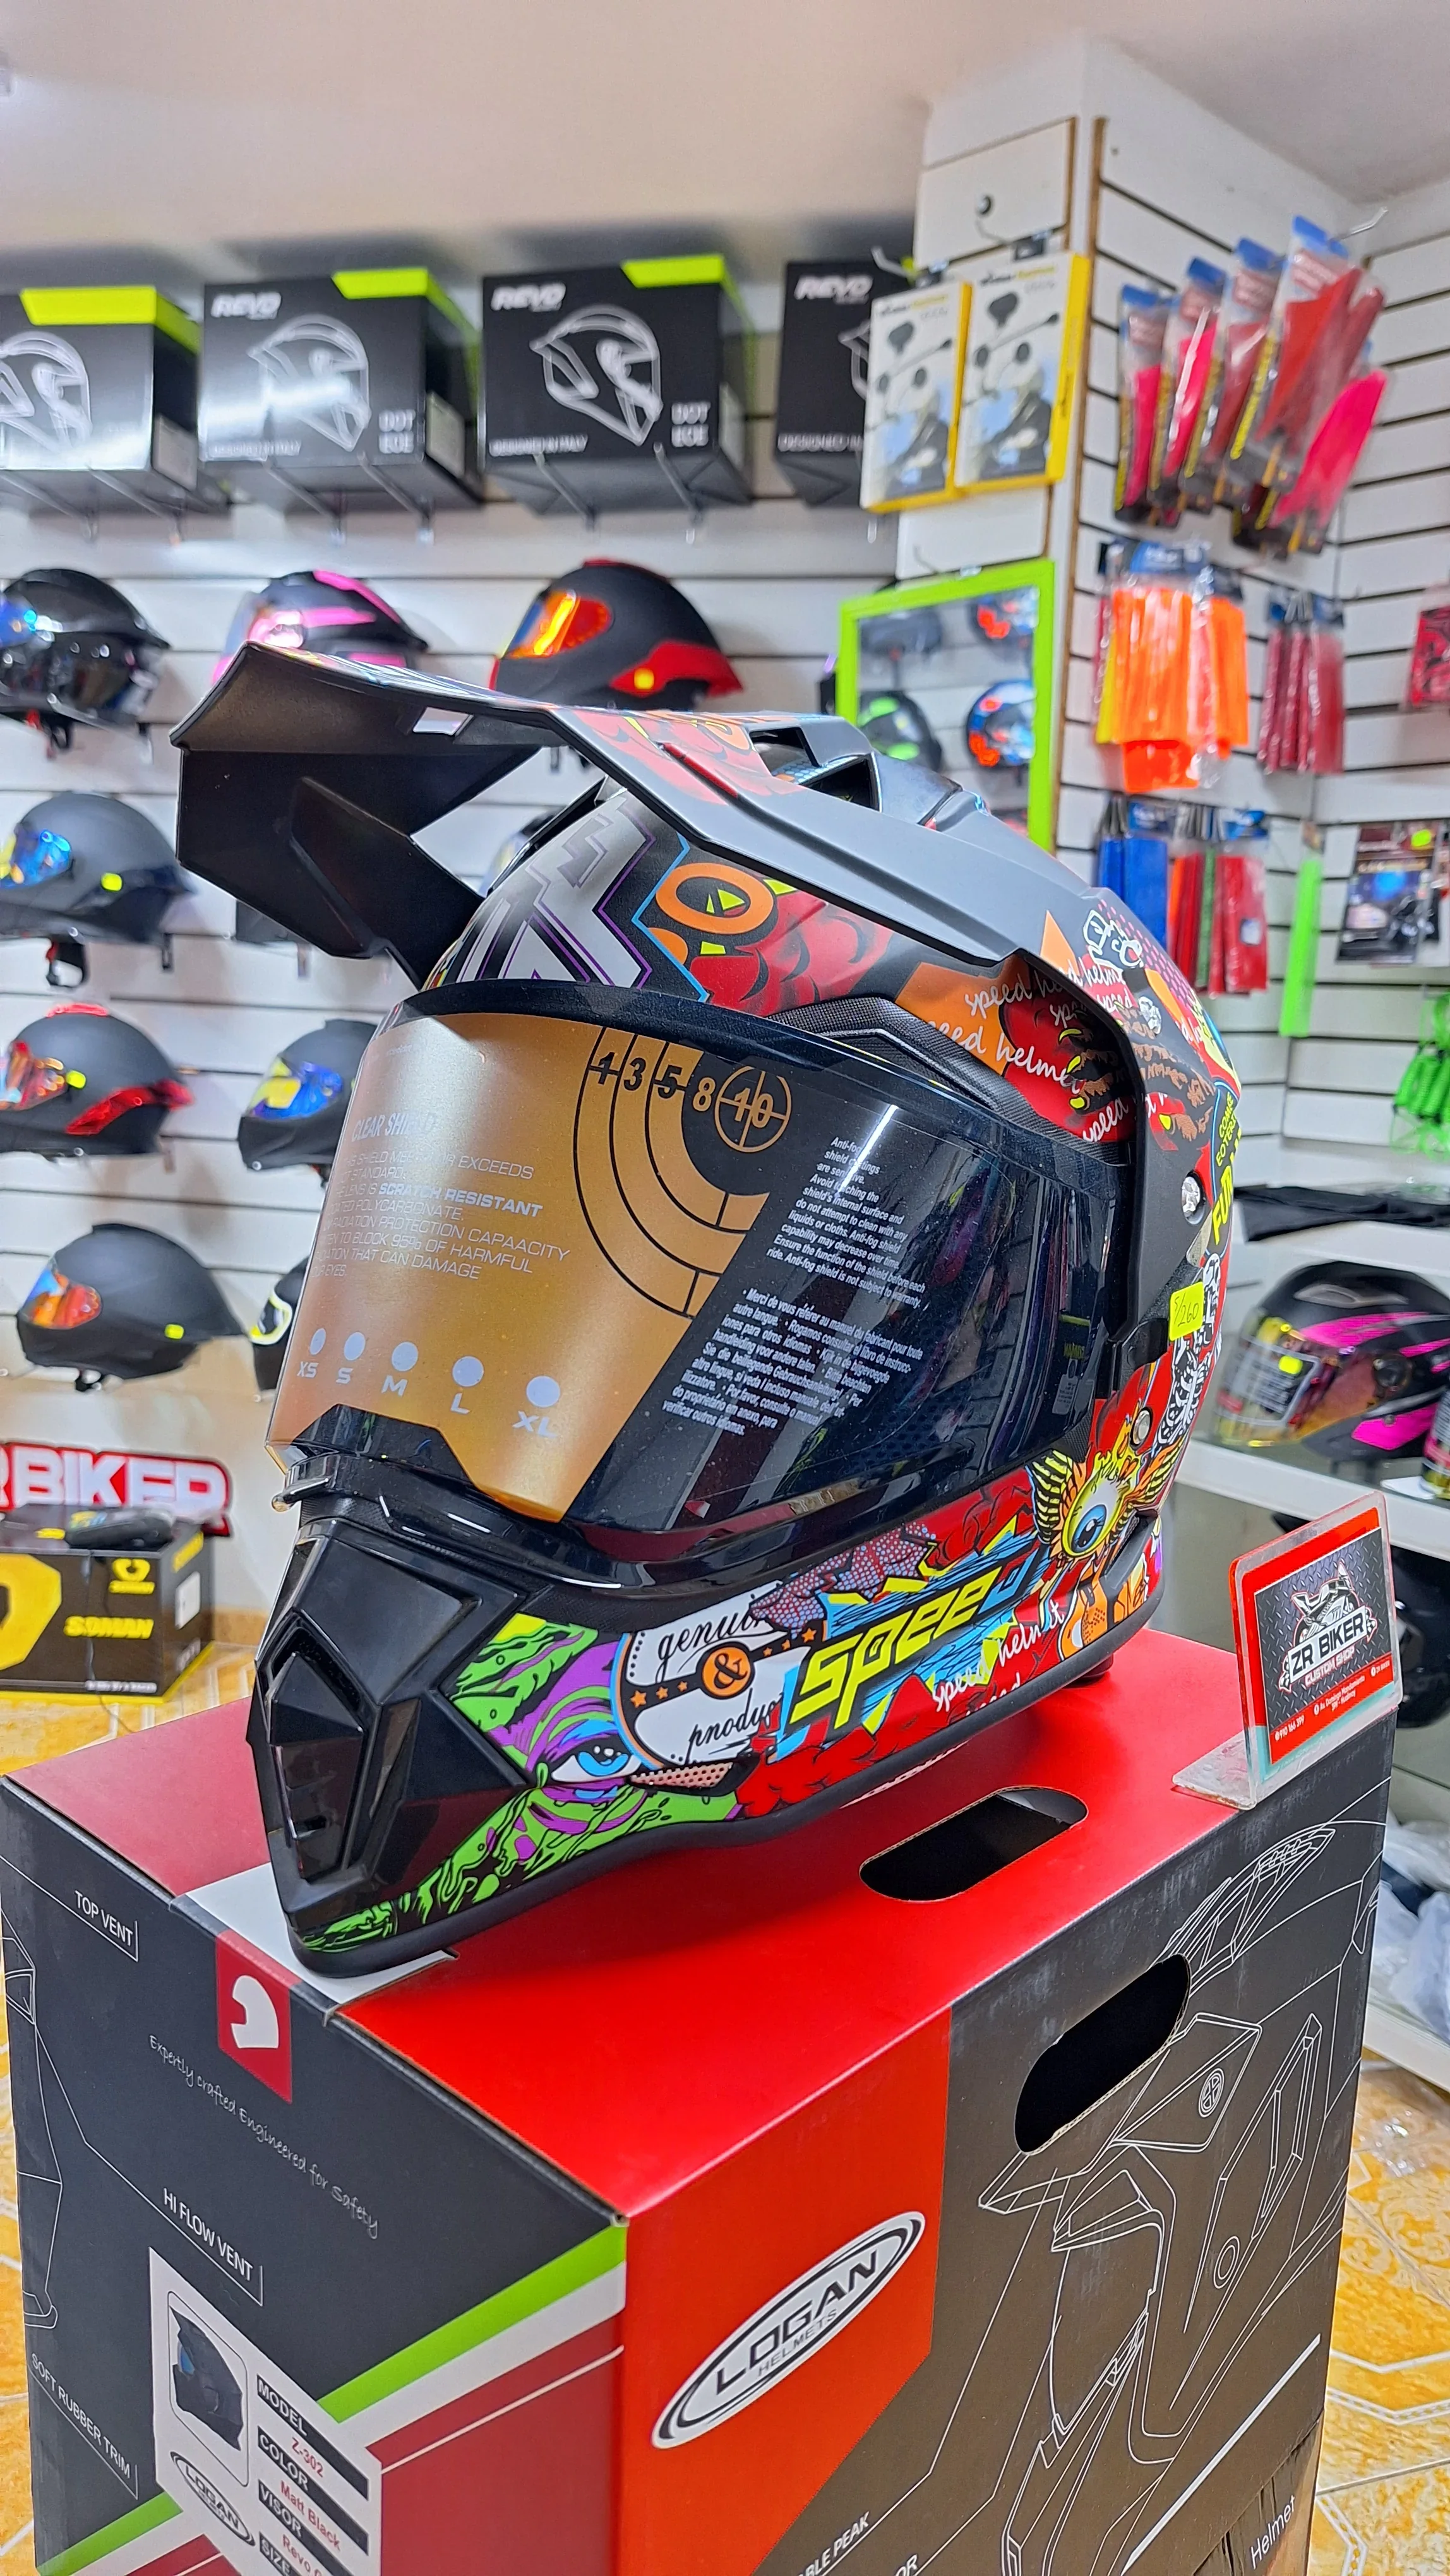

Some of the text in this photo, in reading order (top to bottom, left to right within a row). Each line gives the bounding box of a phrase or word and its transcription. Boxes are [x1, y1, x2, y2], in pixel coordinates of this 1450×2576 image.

[211, 292, 282, 318] REVO
[490, 282, 566, 311] REVO
[964, 973, 1033, 1020] speed
[623, 1057, 646, 1091] 3
[657, 1064, 683, 1099] 5
[692, 1076, 716, 1112] 8
[734, 1087, 774, 1128] 10
[458, 1155, 534, 1179] EXCEEDS
[817, 1162, 830, 1172] are
[824, 1150, 880, 1174] shield ctings
[445, 1188, 543, 1217] RESISTANT
[802, 1186, 833, 1203] shield's
[860, 1205, 889, 1220] surface
[888, 1214, 905, 1224] and
[809, 1173, 879, 1203] Avoid toching the
[378, 1215, 571, 1261] PROTECTION CAPAACITY
[788, 1209, 902, 1254] liquids or cloths. Anti-fog shield
[795, 1198, 908, 1243] do not attempt to clean with any
[352, 1231, 390, 1246] BLOCK
[424, 1239, 448, 1253] OF
[450, 1244, 533, 1273] HARMFUL
[352, 1248, 482, 1280] THAT CAN DAMAGE
[773, 1234, 925, 1293] Ensure the function of the shield before each
[781, 1224, 900, 1269] capability may decrease over time.
[765, 1246, 783, 1260] ride.
[783, 1252, 816, 1273] Anti-fog
[814, 1263, 840, 1279] shield
[837, 1270, 846, 1281] is
[844, 1275, 860, 1286] not
[858, 1279, 885, 1296] subject
[883, 1285, 892, 1297] to
[297, 1361, 558, 1438] XS S M L XL
[0, 1445, 229, 1518] BIKER
[1291, 1612, 1364, 1676] ZR BIKER
[1305, 1645, 1356, 1688] CUSTOM SHOP
[713, 1652, 748, 1690] &
[75, 1890, 133, 1947] TOP VENT
[148, 2034, 378, 2239] Expertly crafted Engineered for Safety
[163, 2187, 254, 2282] HI FLOW VENT
[716, 2249, 878, 2396] LOGAN
[757, 2308, 837, 2376] HELMETS
[31, 2352, 131, 2479] SOFT RUBBER TRIM
[258, 2378, 308, 2437] MODEL
[260, 2434, 309, 2491] COLOR
[291, 2436, 324, 2478] Z-302
[185, 2464, 239, 2531] LOGAN
[259, 2483, 303, 2539] VISOR
[280, 2479, 342, 2552] Matt Black
[282, 2534, 312, 2574] Revo
[798, 2510, 870, 2576] BLE PEAK
[1250, 2494, 1295, 2570] Helmet
[260, 2541, 292, 2576] SIZE
